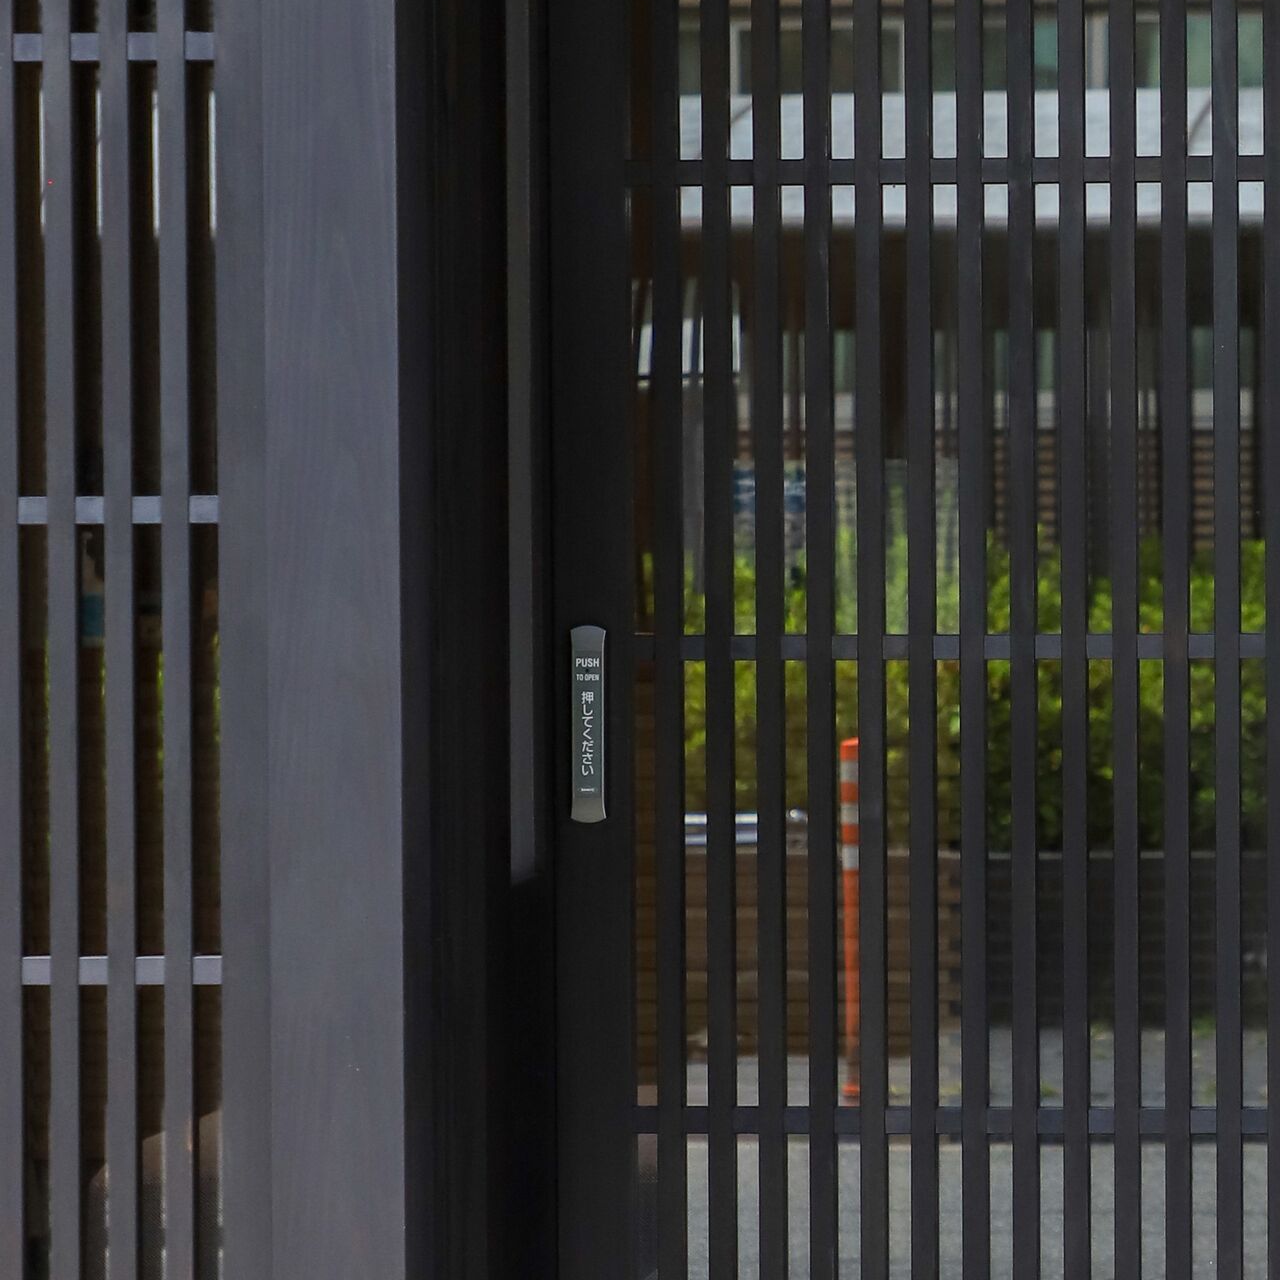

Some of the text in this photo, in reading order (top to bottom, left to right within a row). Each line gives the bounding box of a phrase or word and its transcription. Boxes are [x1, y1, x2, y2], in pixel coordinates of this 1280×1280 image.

[575, 657, 600, 668] PUSH
[576, 673, 600, 681] TO OPEN
[581, 690, 594, 776] 押してください
